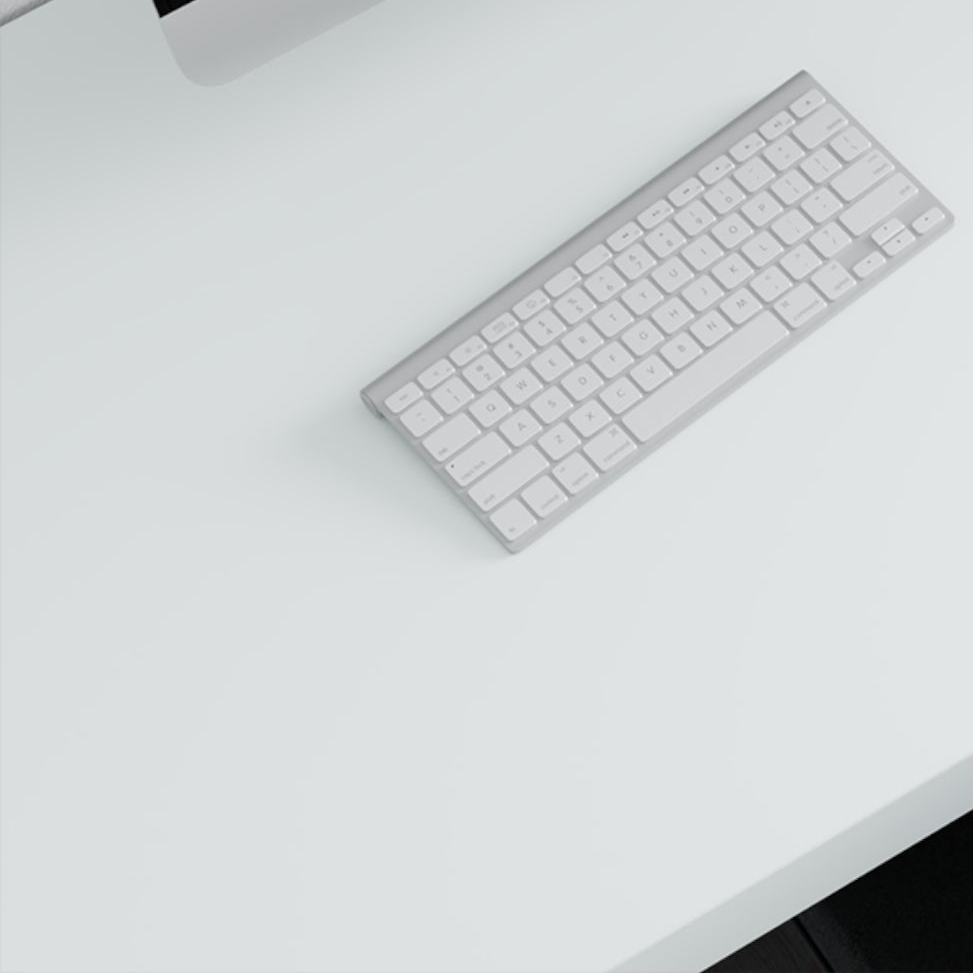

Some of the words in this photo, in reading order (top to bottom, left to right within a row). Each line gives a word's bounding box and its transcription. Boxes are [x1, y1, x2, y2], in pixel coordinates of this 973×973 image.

[514, 379, 528, 391] W
[667, 267, 680, 279] U
[727, 224, 739, 235] O
[614, 387, 627, 399] C
[734, 297, 749, 310] M
[576, 375, 589, 387] D
